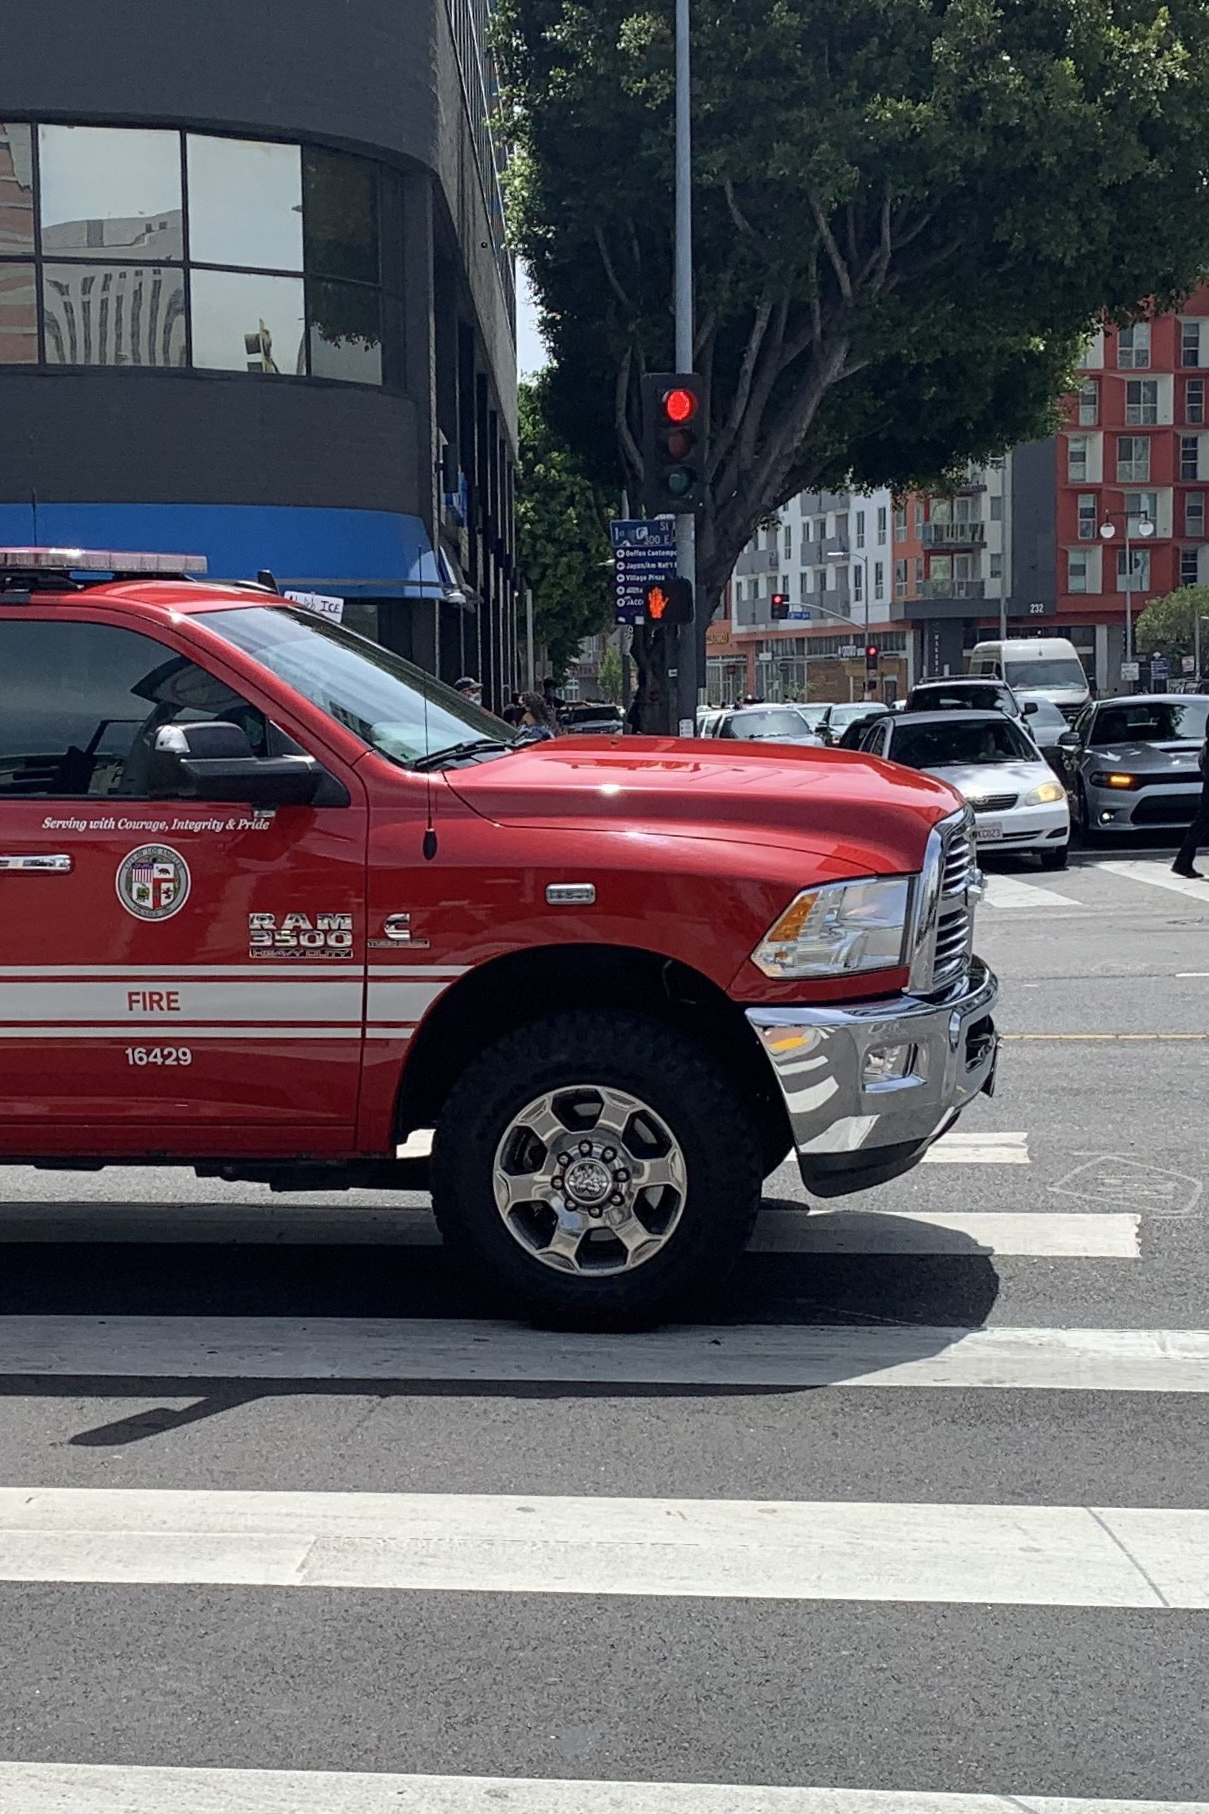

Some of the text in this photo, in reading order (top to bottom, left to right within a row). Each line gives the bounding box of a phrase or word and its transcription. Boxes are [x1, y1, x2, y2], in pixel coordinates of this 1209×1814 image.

[663, 534, 670, 545] E
[625, 574, 647, 582] Village
[319, 600, 341, 614] ICE
[1029, 603, 1045, 614] 232
[41, 816, 270, 833] Serving with Courage, Integrity & Pride
[249, 912, 353, 930] RAM
[249, 930, 353, 947] 3500
[252, 949, 304, 957] HEAVY
[127, 991, 181, 1012] FIRE
[124, 1047, 192, 1067] 16429
